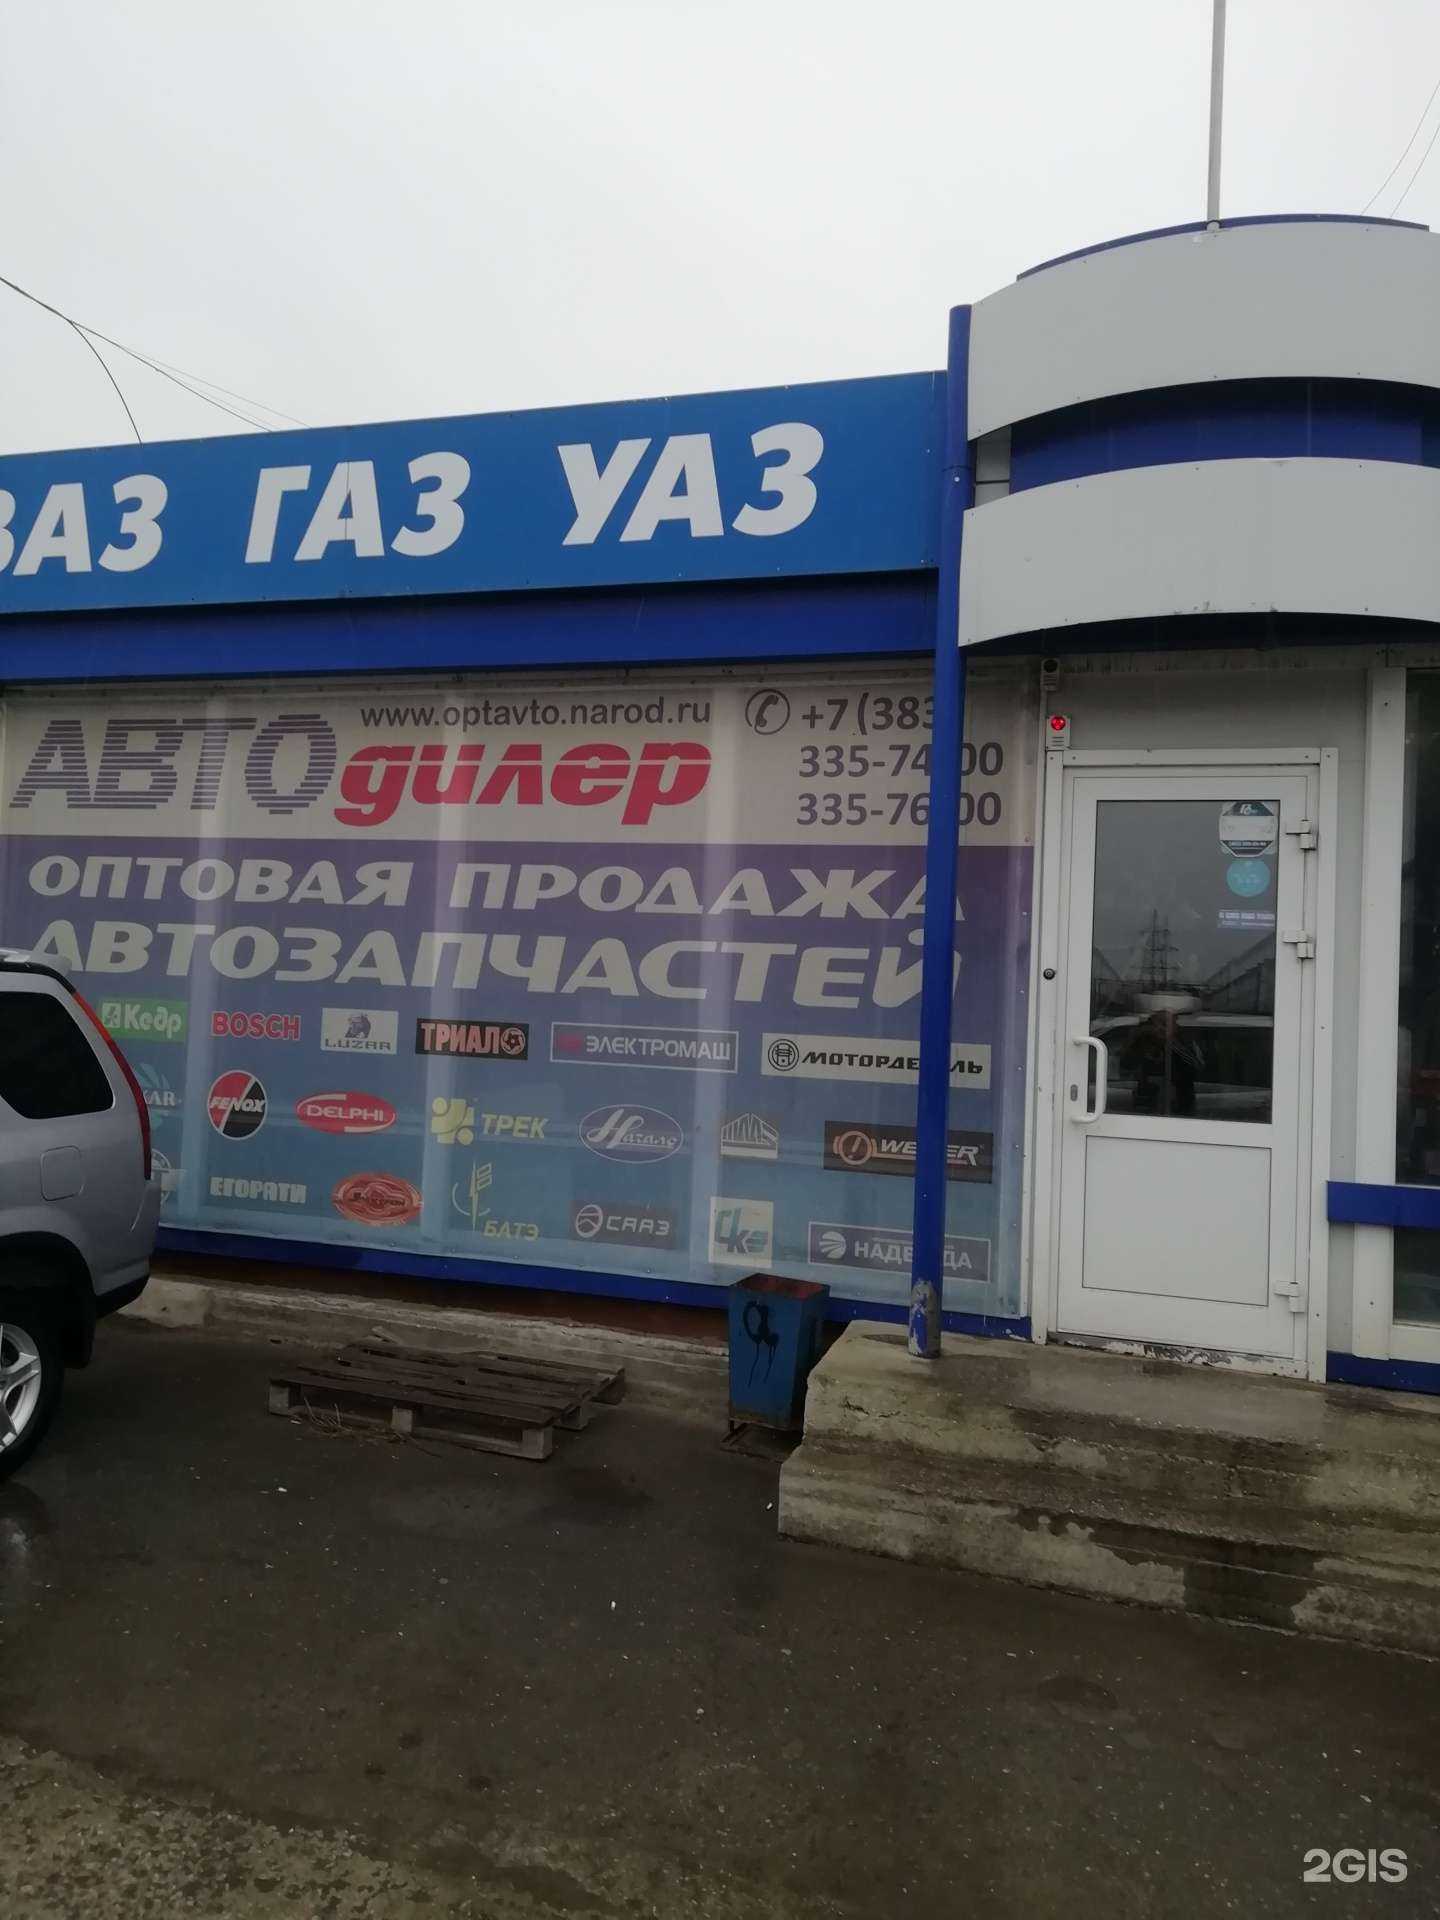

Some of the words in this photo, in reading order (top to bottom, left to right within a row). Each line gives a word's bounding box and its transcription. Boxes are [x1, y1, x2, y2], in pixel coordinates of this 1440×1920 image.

[0, 473, 169, 576] АЗ
[244, 451, 471, 563] ГАЗ
[557, 422, 824, 546] УАЗ
[361, 697, 711, 732] www.optavto.narod.ru
[799, 741, 1003, 778] 335-7400
[796, 791, 1002, 827] 335-7600
[28, 855, 414, 906] ОПТОВАЯ
[449, 862, 966, 921] ПРОДАЖА
[31, 919, 962, 1009] АВТОЗАПЧАСТЕЙ
[211, 1011, 300, 1040] BOSCH
[325, 1038, 391, 1050] LUZAR
[586, 1035, 730, 1061] ЭЛЕКТРОМАШ
[209, 1095, 266, 1114] FENOX
[306, 1103, 385, 1122] DELPHI
[482, 1114, 548, 1139] ТРЕК
[881, 1138, 979, 1167] WEER
[484, 1220, 539, 1241] БАТЭ
[854, 1241, 972, 1271] НАДЕДА
